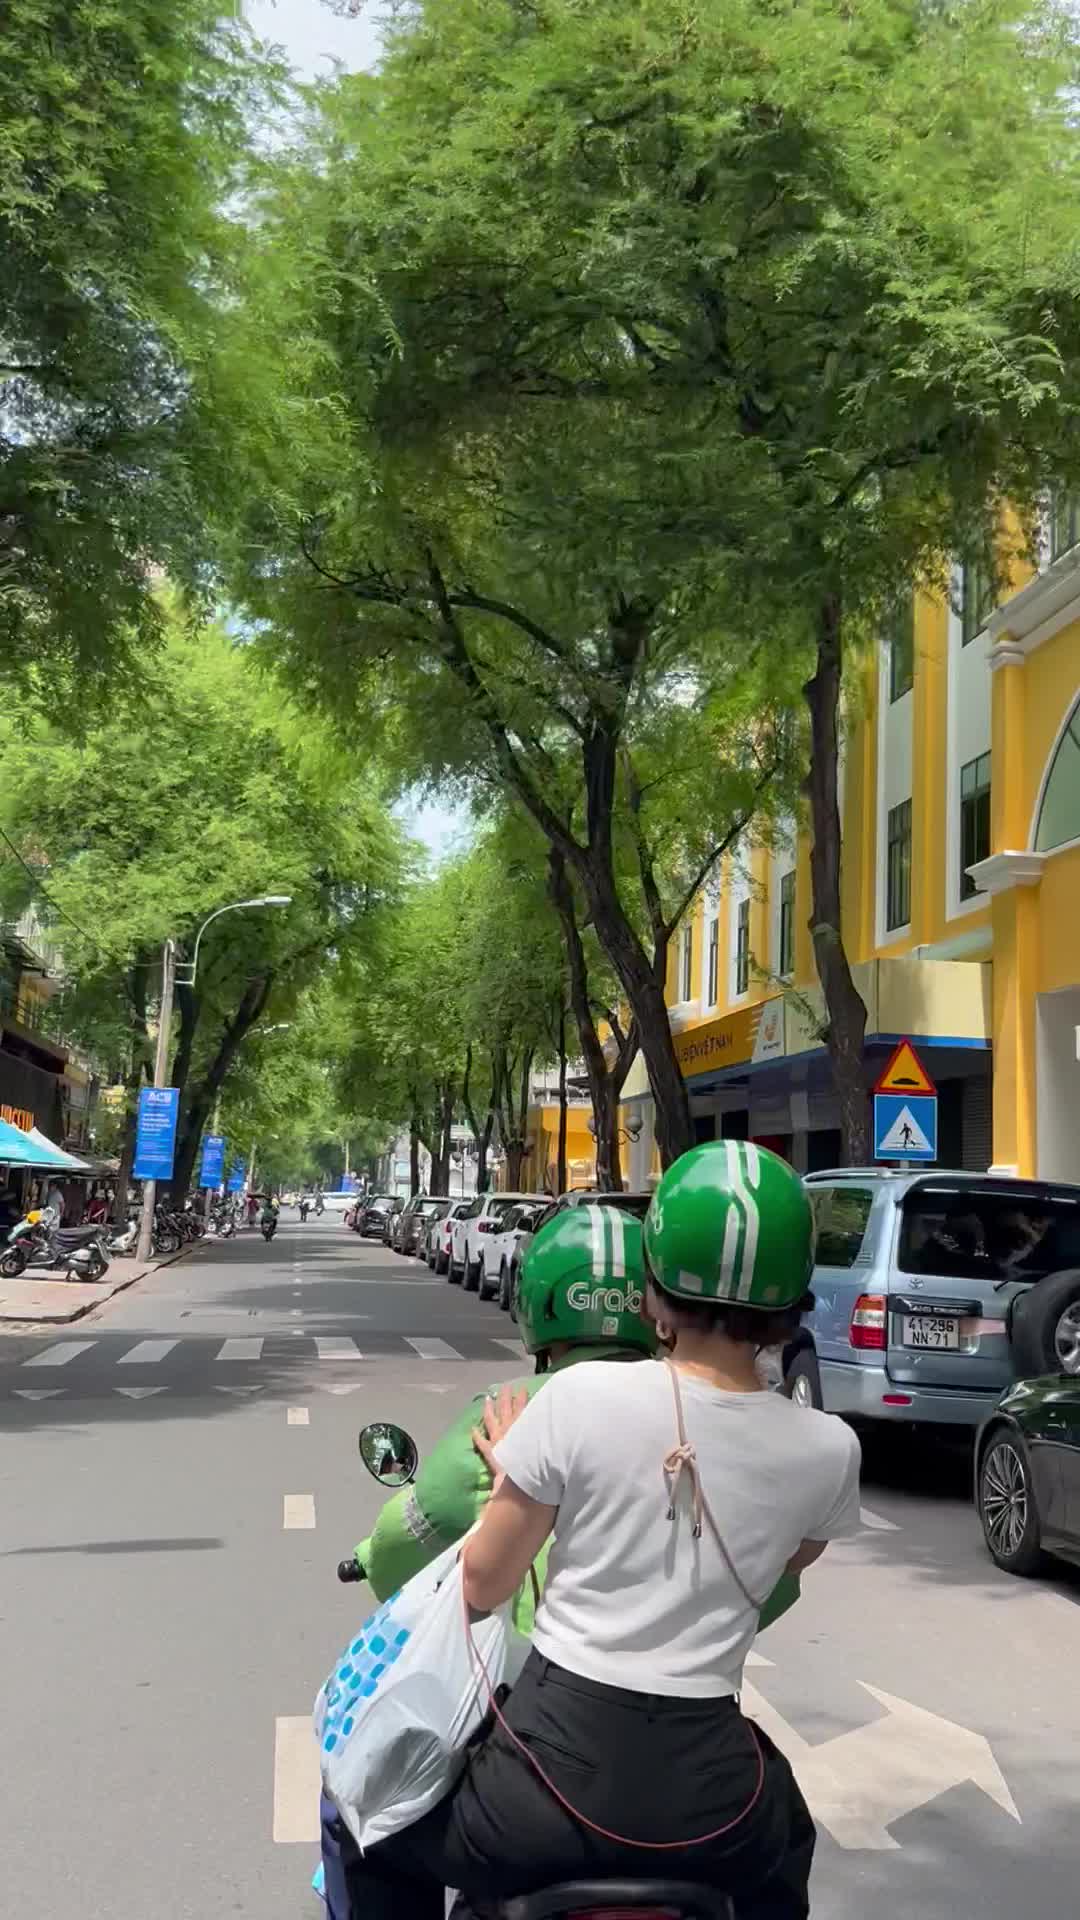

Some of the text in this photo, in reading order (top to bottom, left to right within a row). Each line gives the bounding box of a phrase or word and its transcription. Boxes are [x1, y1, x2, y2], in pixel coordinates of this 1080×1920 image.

[147, 1092, 172, 1104] ACB
[567, 1280, 643, 1313] Grab
[912, 1331, 948, 1346] NN-71
